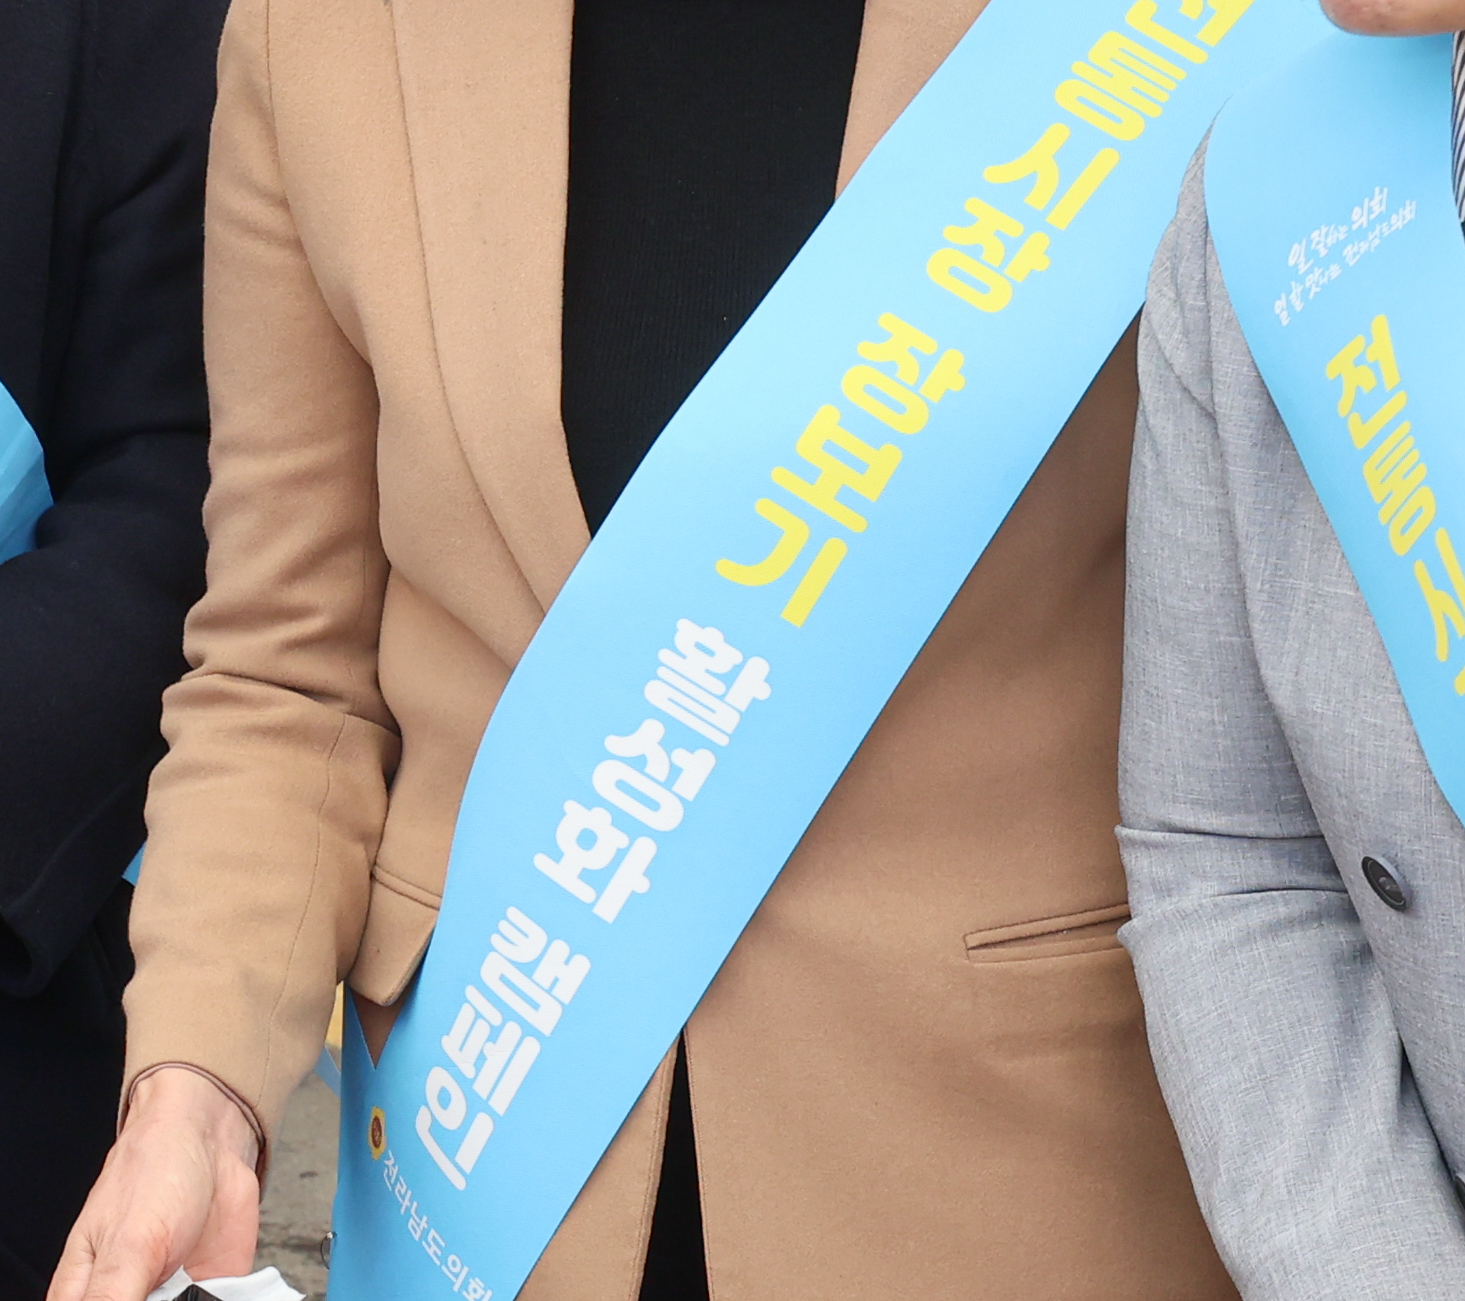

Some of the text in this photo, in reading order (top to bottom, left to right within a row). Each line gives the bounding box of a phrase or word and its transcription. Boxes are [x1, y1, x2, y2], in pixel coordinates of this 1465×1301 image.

[716, 312, 966, 627] 장보기
[533, 618, 771, 924] 활성화
[416, 906, 591, 1191] 캠페인
